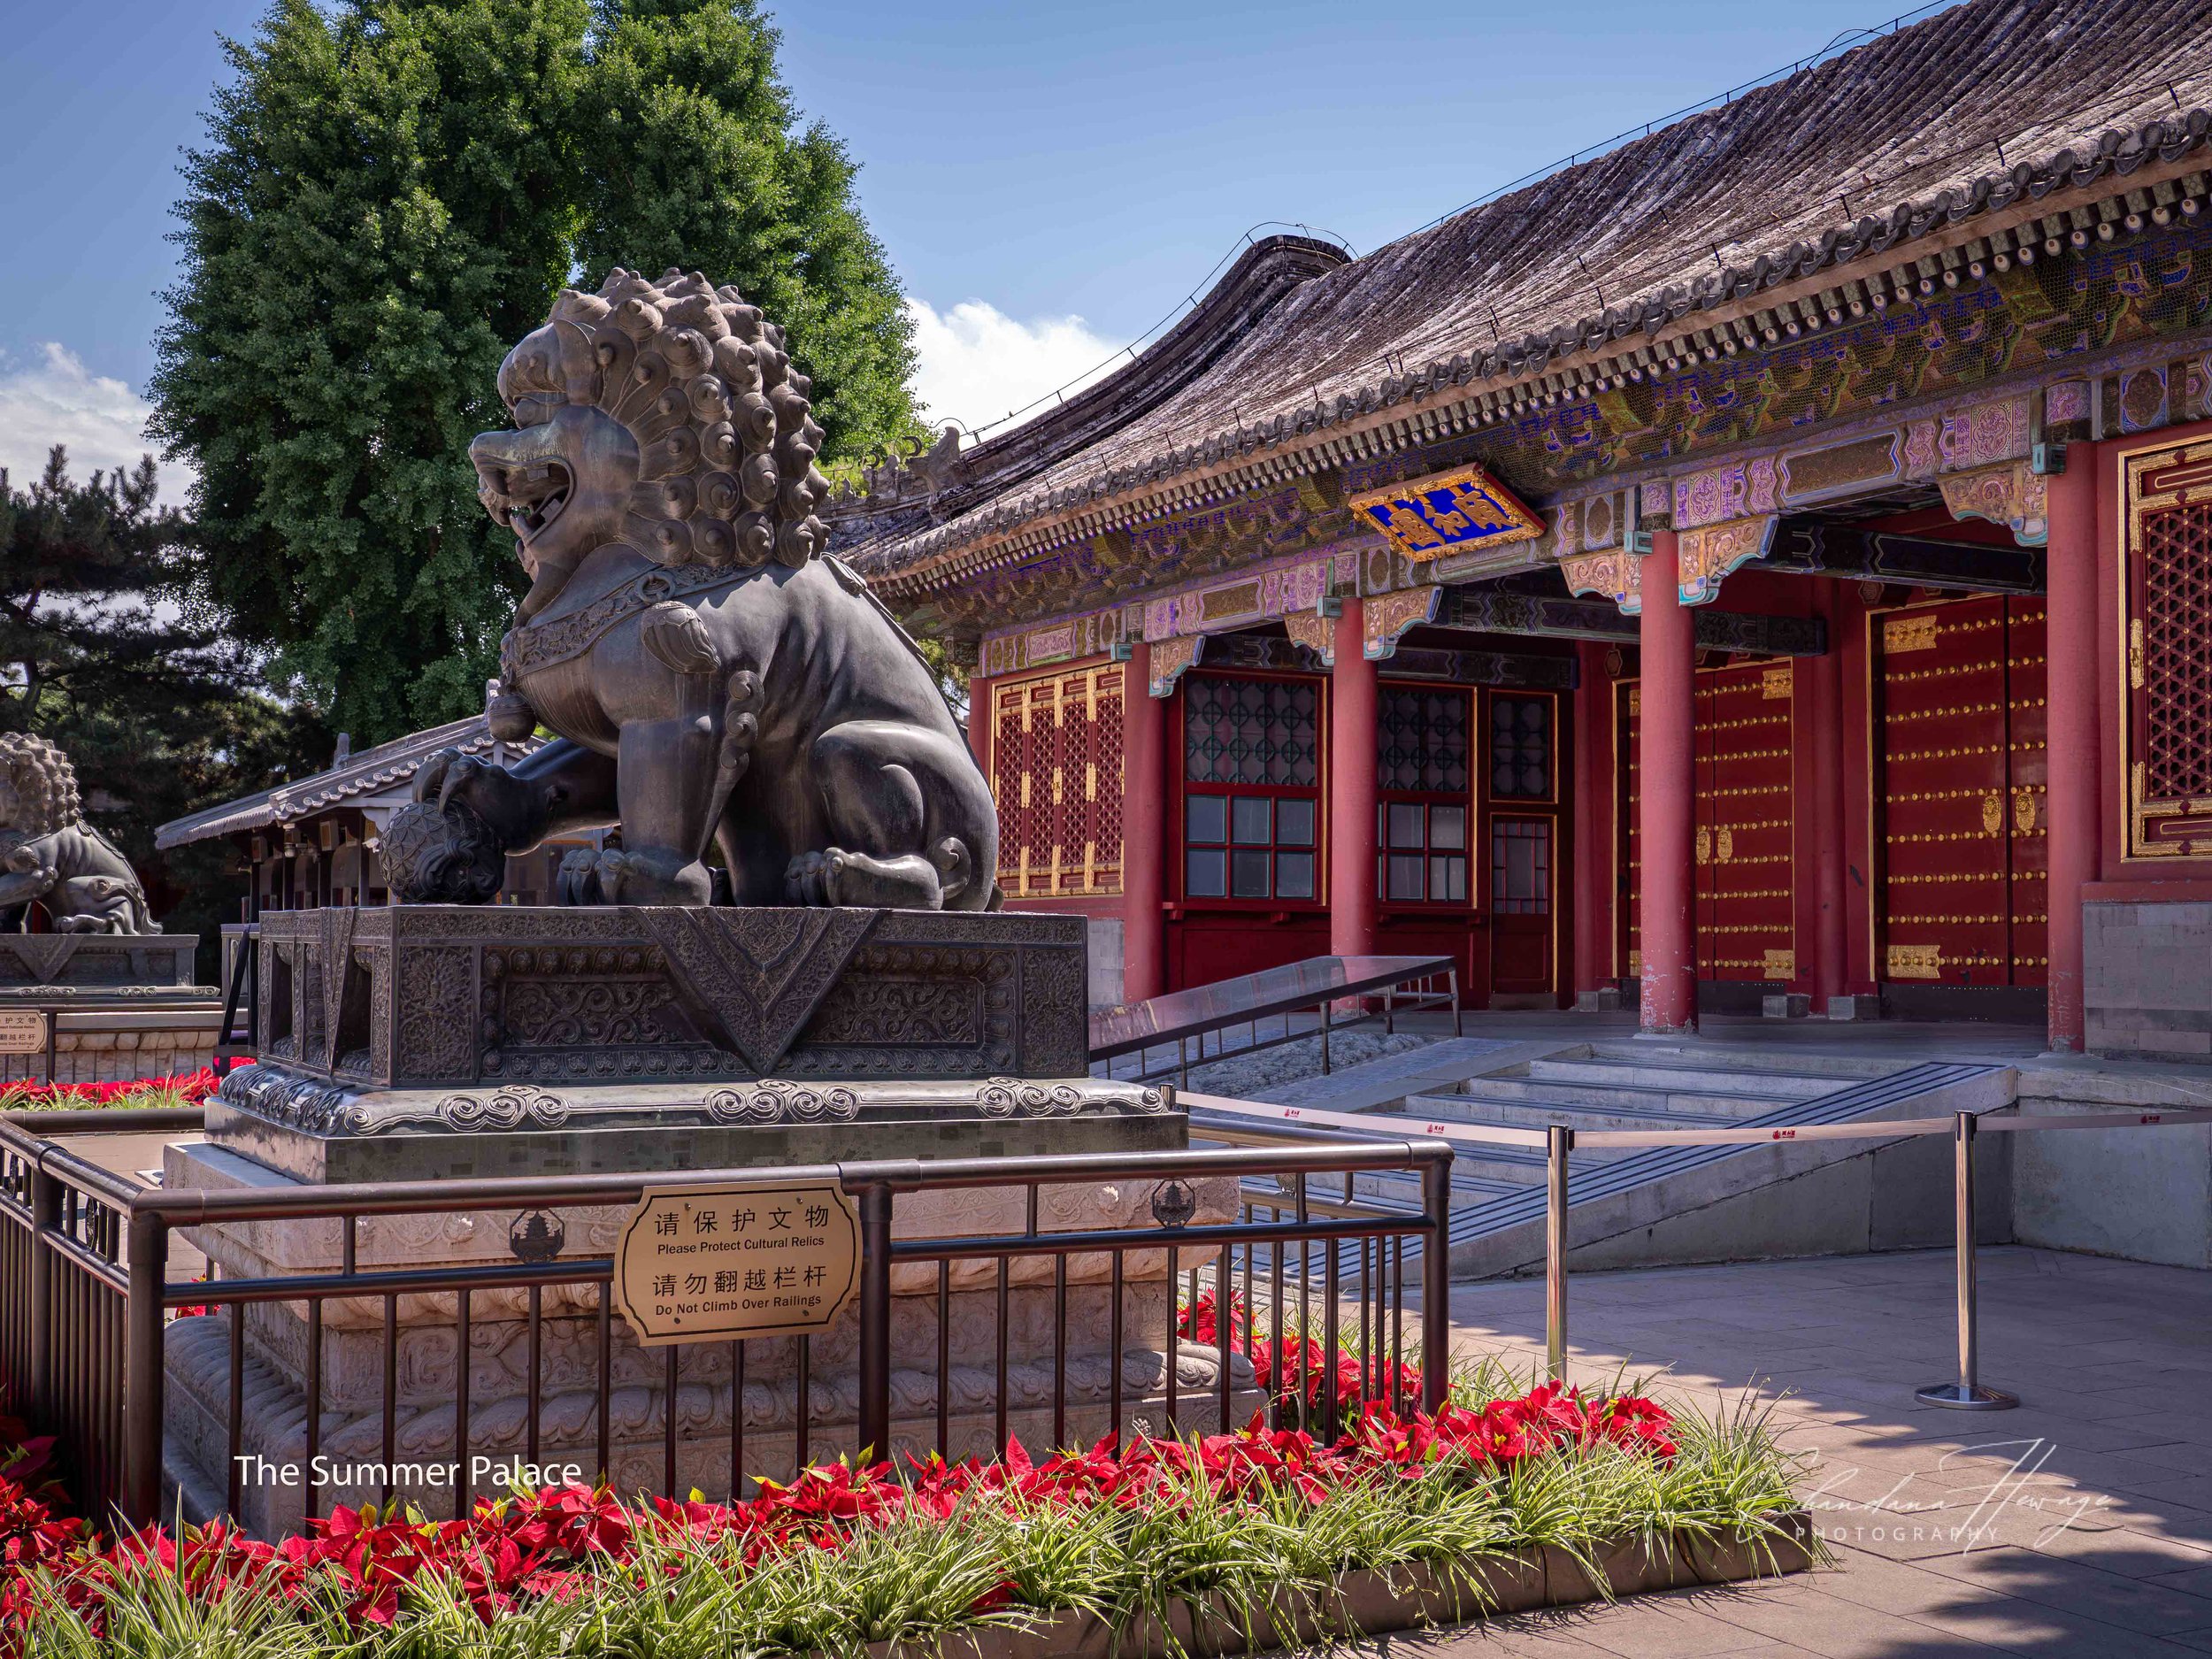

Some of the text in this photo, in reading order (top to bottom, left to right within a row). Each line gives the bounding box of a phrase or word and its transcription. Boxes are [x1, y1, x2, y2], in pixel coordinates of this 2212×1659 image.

[655, 1204, 829, 1237] 请保护文物
[657, 1235, 825, 1256] Please Protect Cultural Relics
[652, 1264, 827, 1298] 请勿翻越栏杆
[656, 1294, 822, 1316] Do Not Climb Over Railings
